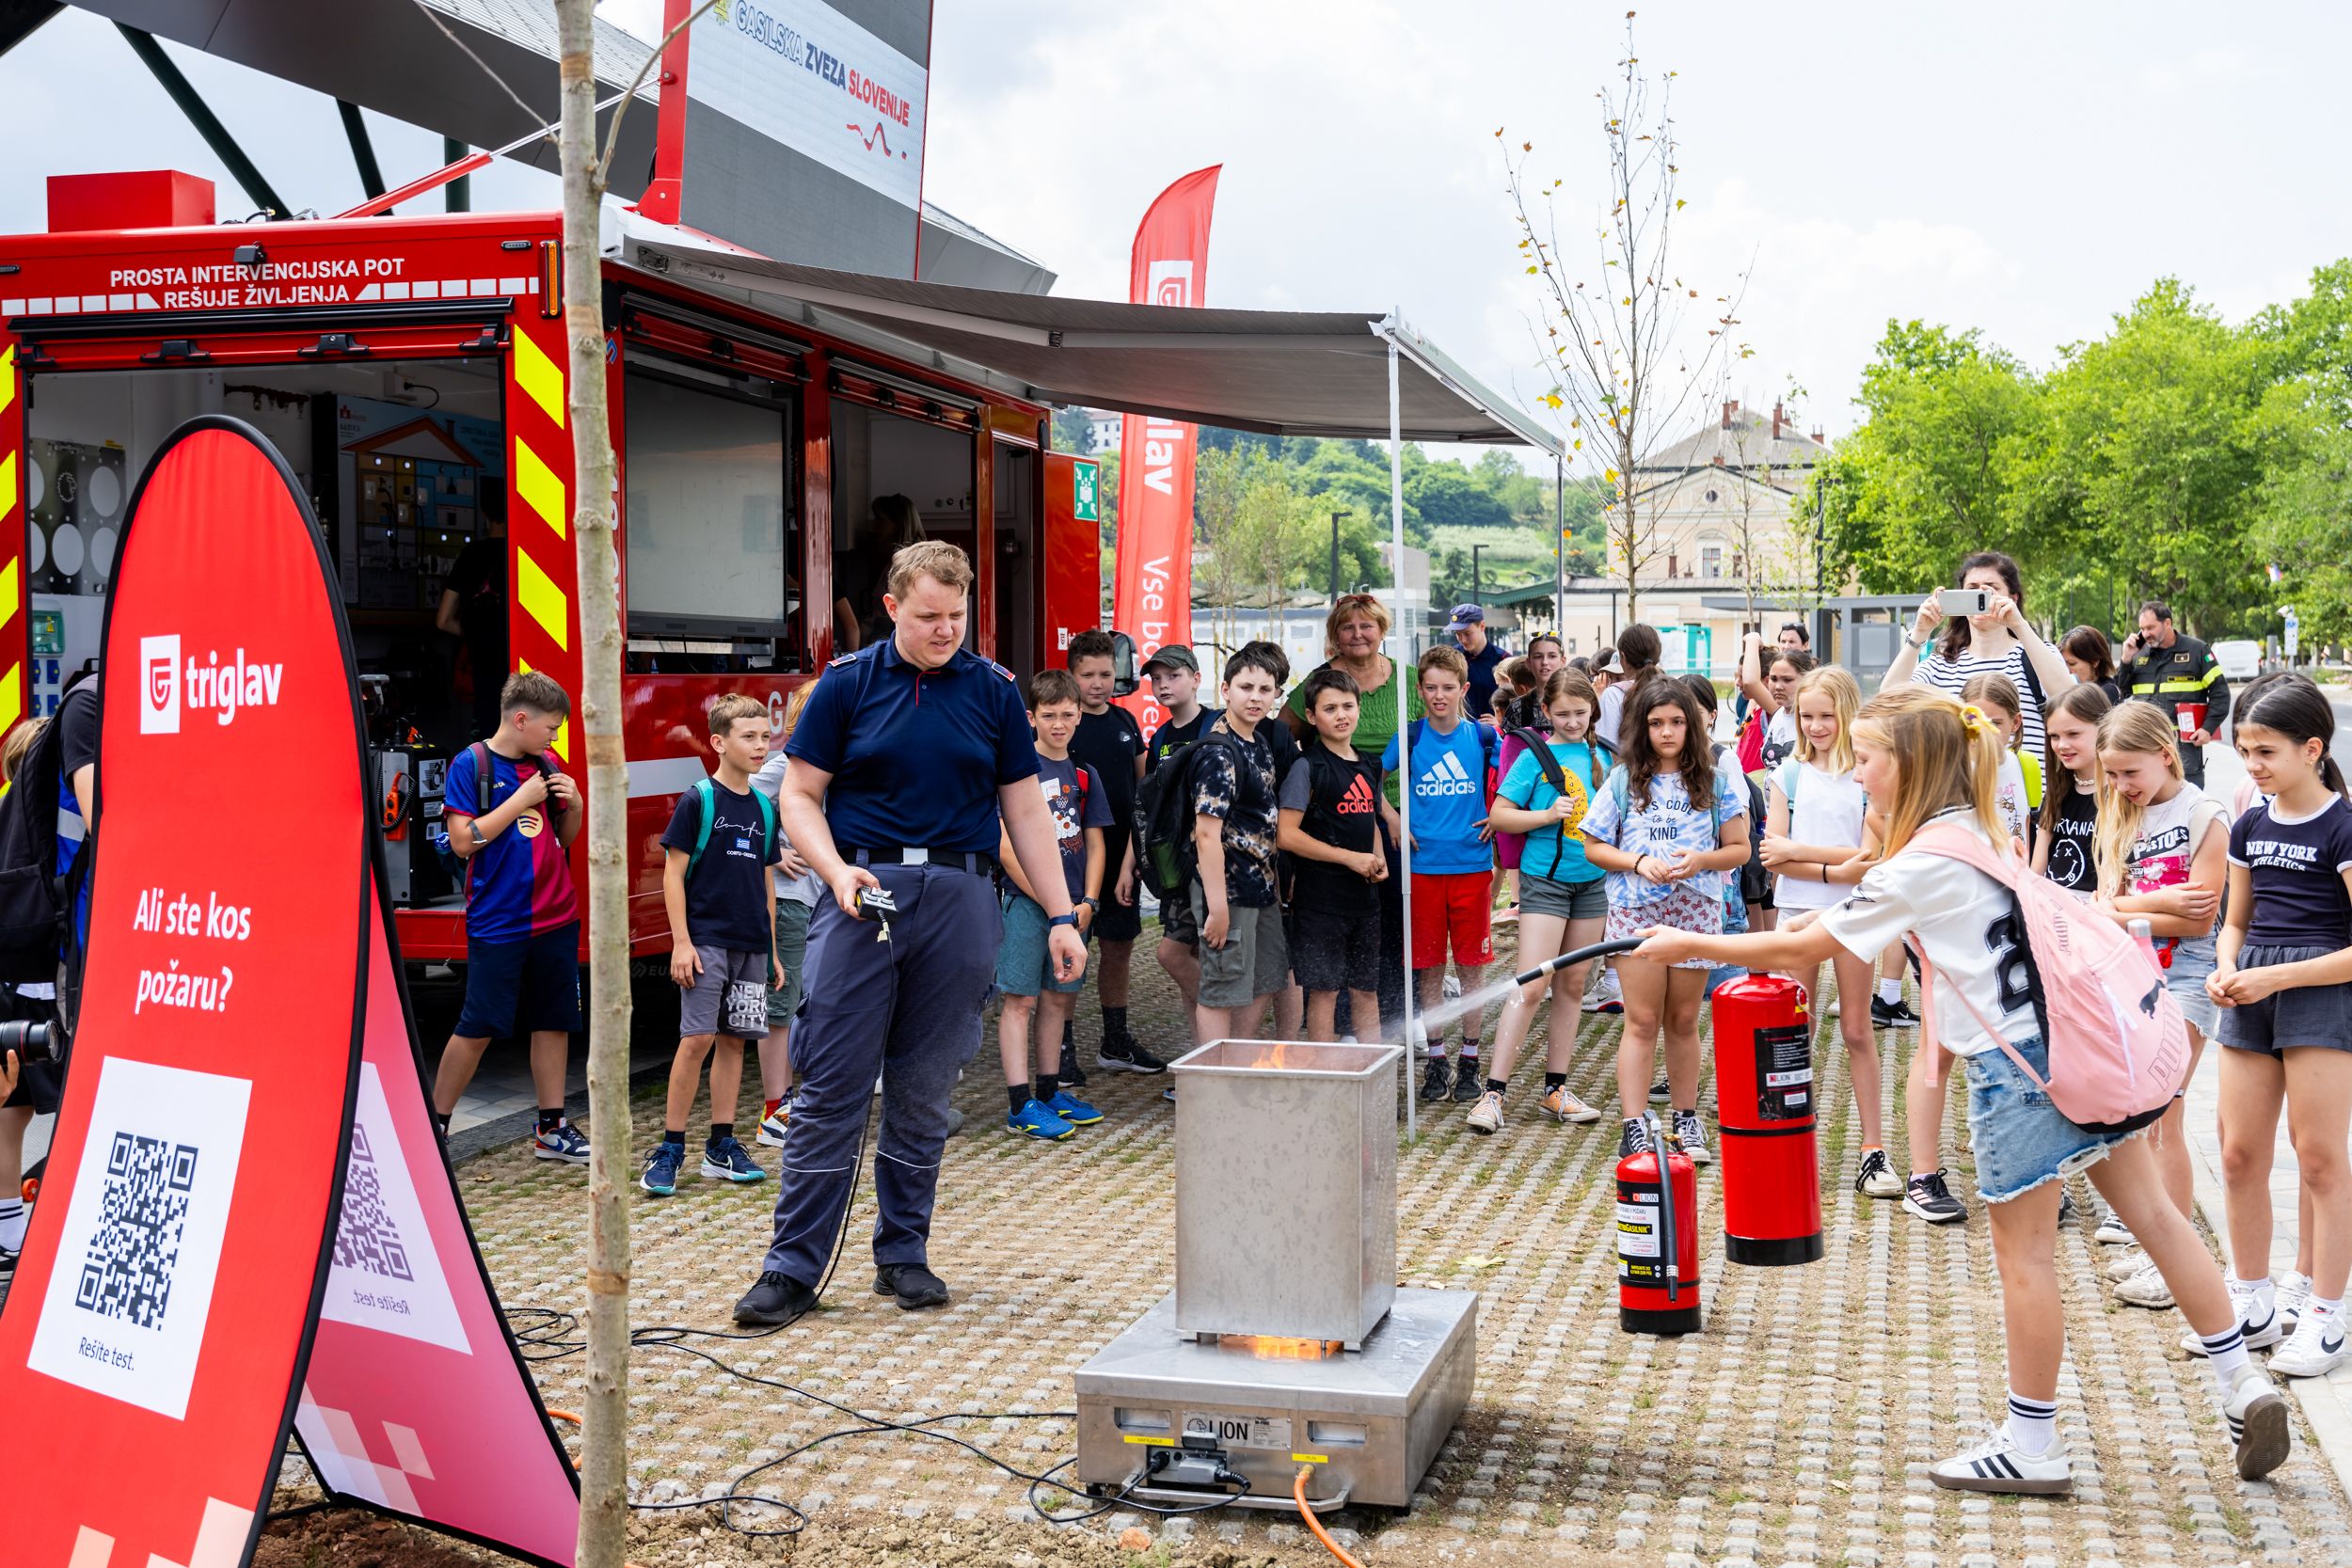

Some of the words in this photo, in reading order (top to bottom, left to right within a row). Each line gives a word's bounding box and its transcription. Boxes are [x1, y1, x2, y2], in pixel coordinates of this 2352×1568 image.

[736, 0, 803, 66] GASILSKA
[805, 42, 847, 90] ZVEZA
[849, 69, 910, 127] SLOVENIJE
[110, 267, 187, 287] PROSTA
[191, 260, 359, 283] INTERVENCIJSKA
[364, 258, 405, 276] POT
[164, 286, 241, 309] REŠUJE
[245, 284, 349, 306] ŽIVLJENJA
[1142, 556, 1170, 610] Vse
[185, 647, 283, 726] triglav
[1415, 779, 1476, 797] adidas
[1652, 815, 1663, 823] to
[1666, 814, 1677, 823] be
[1666, 800, 1693, 816] COOL
[714, 816, 766, 837] Corfu
[1649, 827, 1677, 841] KIND
[2246, 841, 2279, 856] NEW
[2278, 843, 2317, 862] YORK
[134, 887, 164, 932] Ali
[166, 893, 201, 936] ste
[206, 891, 251, 941] kos
[135, 958, 233, 1015] požaru?
[730, 983, 766, 1000] NEW
[726, 997, 768, 1014] YORK
[728, 1011, 766, 1028] CITY
[79, 1337, 110, 1362] Rešite
[112, 1347, 135, 1370] test.
